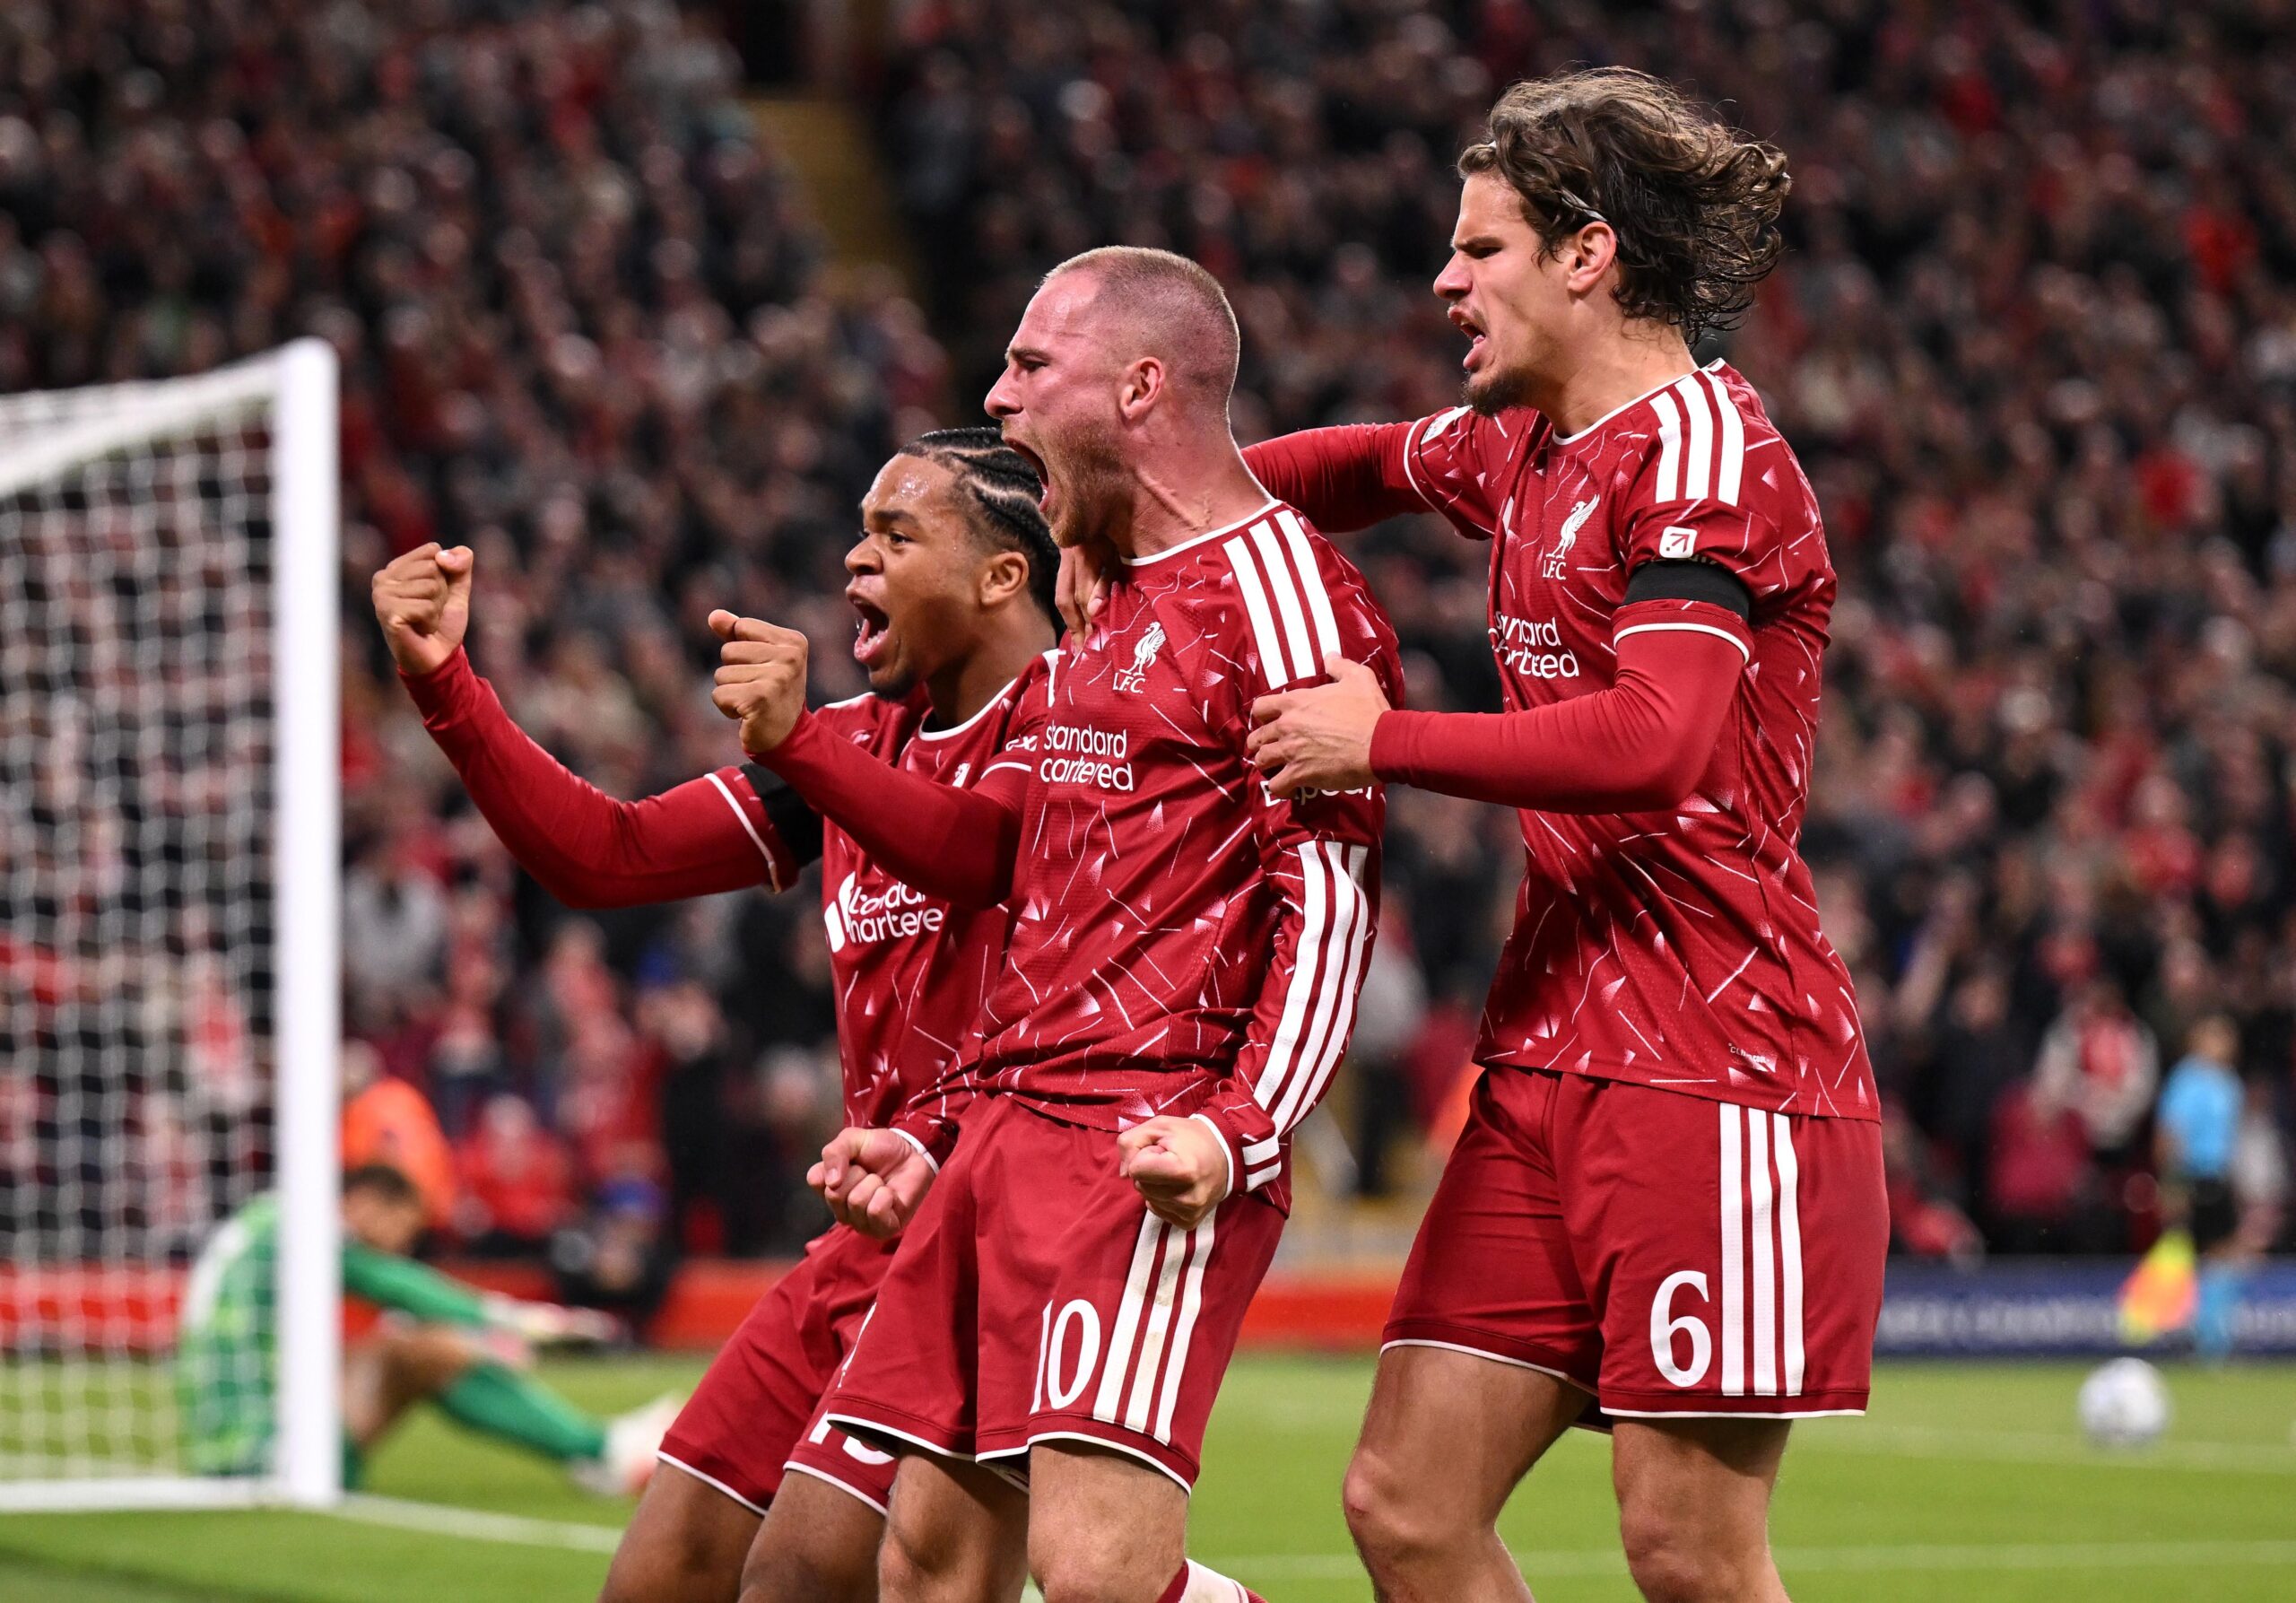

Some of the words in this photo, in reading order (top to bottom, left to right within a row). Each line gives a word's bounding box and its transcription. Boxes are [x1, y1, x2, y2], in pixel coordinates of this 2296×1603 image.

[1039, 755, 1134, 792] cartered
[848, 908, 944, 944] hartere
[1029, 1298, 1101, 1415] 10
[1650, 1270, 1712, 1388] 6
